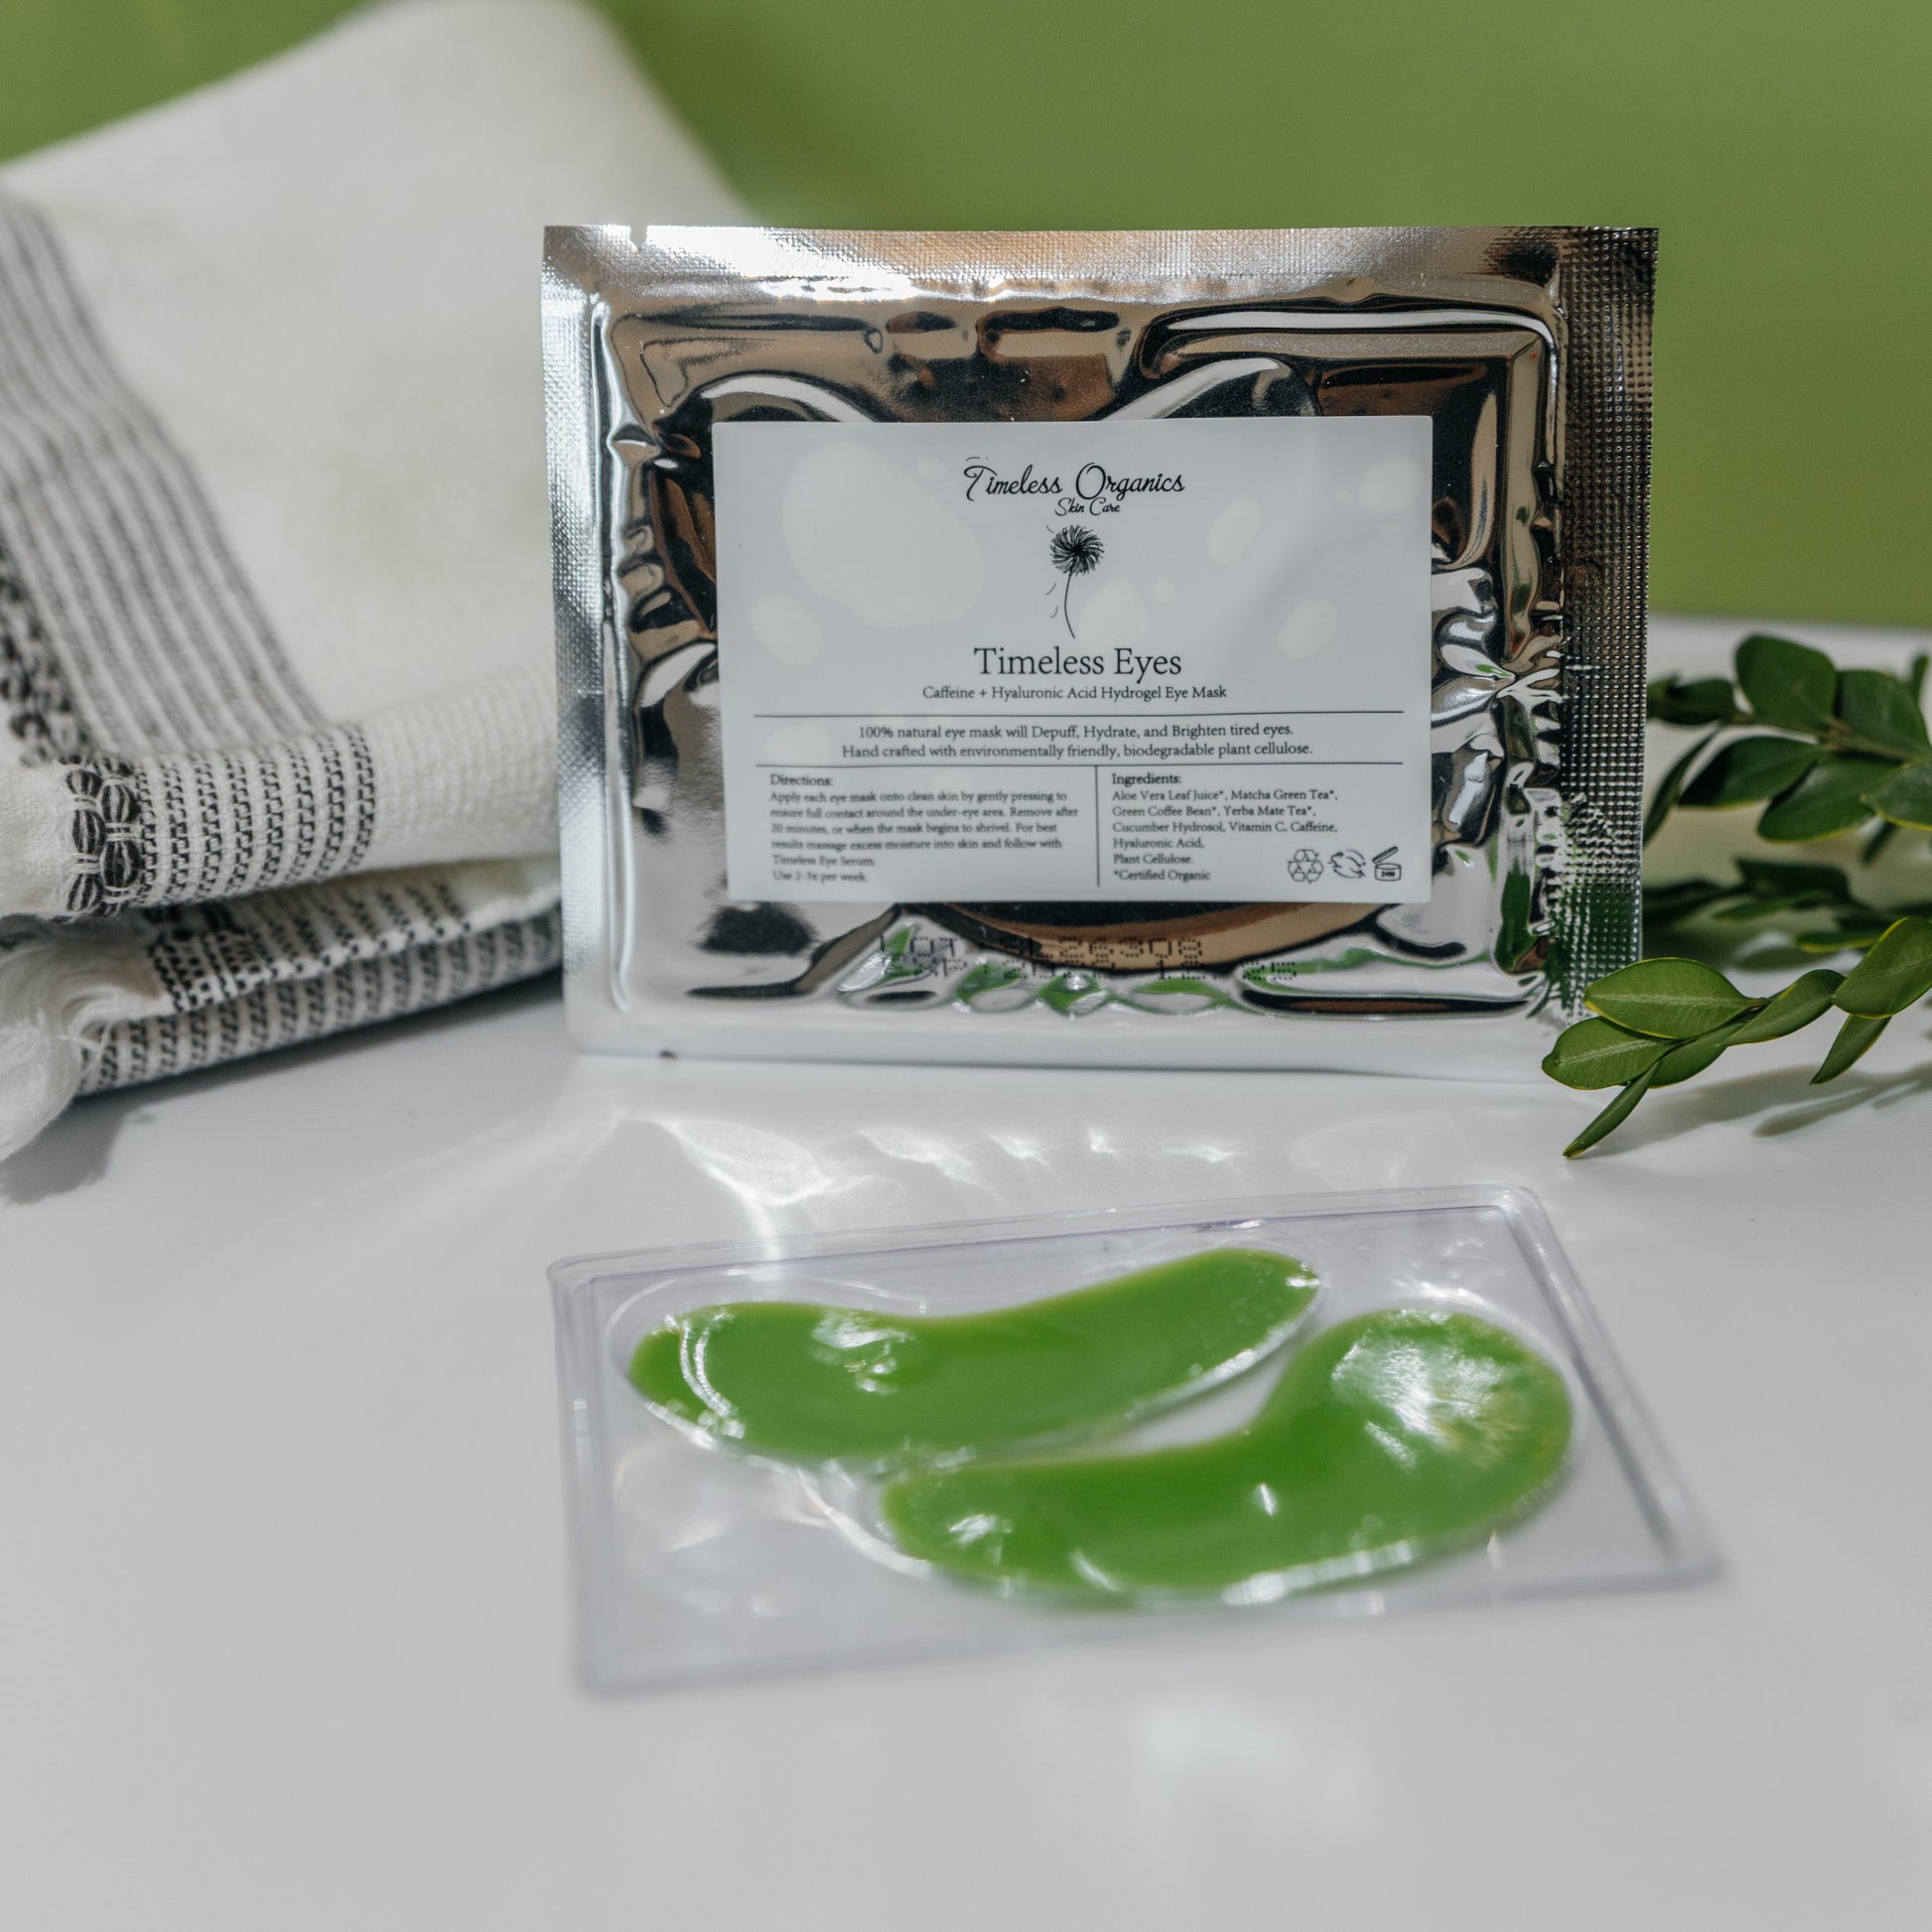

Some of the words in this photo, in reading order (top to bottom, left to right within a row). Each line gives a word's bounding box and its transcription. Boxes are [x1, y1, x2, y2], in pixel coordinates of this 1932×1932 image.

[963, 464, 1063, 501] Timeless
[1075, 462, 1185, 501] Organics
[1054, 497, 1085, 516] Skin
[1089, 497, 1121, 515] Care
[974, 646, 1104, 674] Timeless
[1114, 648, 1181, 684] Eyes
[921, 685, 976, 699] Caffeine
[991, 685, 1063, 703] Hyaluronic
[1066, 685, 1098, 699] Acid
[1101, 685, 1162, 703] Hydrogel
[1165, 685, 1189, 703] Eye
[1191, 684, 1228, 699] Mask
[860, 726, 895, 739] 100%
[897, 725, 942, 739] natural
[944, 729, 966, 742] eye
[969, 725, 1003, 739] mask
[1005, 724, 1029, 739] will
[1032, 724, 1080, 742] Depuff,
[1083, 724, 1141, 742] Hydrate,
[1143, 724, 1169, 738] and
[1172, 723, 1227, 741] Brighten
[1229, 722, 1261, 737] tired
[1262, 725, 1294, 740] eyes.
[842, 744, 880, 759] Hand
[882, 744, 926, 758] crafted
[928, 744, 957, 758] with
[959, 744, 1065, 760] environmentally
[1066, 744, 1121, 760] friendly,
[1123, 742, 1215, 760] biodegradable
[1217, 742, 1252, 759] plant
[1253, 741, 1313, 756] cellulose.
[1111, 771, 1182, 788] Ingredients:
[769, 790, 802, 805] Apply
[802, 791, 828, 803] each
[828, 794, 848, 806] eye
[849, 790, 878, 803] mask
[879, 792, 905, 802] onto
[906, 790, 935, 802] clean
[936, 790, 959, 802] skin
[960, 790, 975, 804] by
[976, 789, 1010, 805] gently
[1010, 791, 1055, 805] pressing
[1055, 791, 1068, 801] to
[1112, 789, 1138, 801] Aloe
[1139, 789, 1166, 801] Vera
[1168, 788, 1192, 801] Leaf
[1230, 788, 1272, 800] Matcha
[1273, 788, 1308, 800] Green
[769, 809, 804, 818] ensure
[805, 806, 823, 819] full
[824, 808, 865, 819] contact
[865, 806, 905, 819] around
[906, 805, 924, 818] the
[981, 808, 1007, 818] area.
[1009, 805, 1053, 818] Remove
[1054, 805, 1079, 817] after
[1111, 805, 1146, 817] Green
[1147, 804, 1183, 817] Coffee
[1223, 804, 1255, 817] Yerba
[1257, 805, 1286, 817] Mate
[831, 826, 844, 835] or
[845, 823, 875, 835] when
[876, 822, 895, 835] the
[896, 822, 924, 834] mask
[924, 822, 960, 837] begins
[961, 823, 974, 834] to
[1015, 821, 1035, 833] For
[1035, 821, 1058, 833] best
[1112, 821, 1171, 833] Cucumber
[1172, 820, 1226, 835] Hydrosol,
[1228, 821, 1273, 833] Vitamin
[1290, 820, 1338, 833] Caffeine,
[805, 841, 849, 853] massage
[849, 841, 884, 851] excess
[884, 840, 932, 850] moisture
[932, 839, 956, 850] into
[956, 837, 980, 850] skin
[981, 837, 1003, 849] and
[1003, 837, 1037, 849] follow
[1037, 837, 1062, 849] with
[1112, 837, 1173, 851] Hyaluronic
[1175, 836, 1205, 850] Acid,
[771, 853, 817, 866] Timeless
[818, 855, 838, 869] Eye
[1113, 853, 1141, 865] Plant
[771, 870, 793, 882] Use
[819, 873, 838, 885] per
[1167, 869, 1211, 884] Organic
